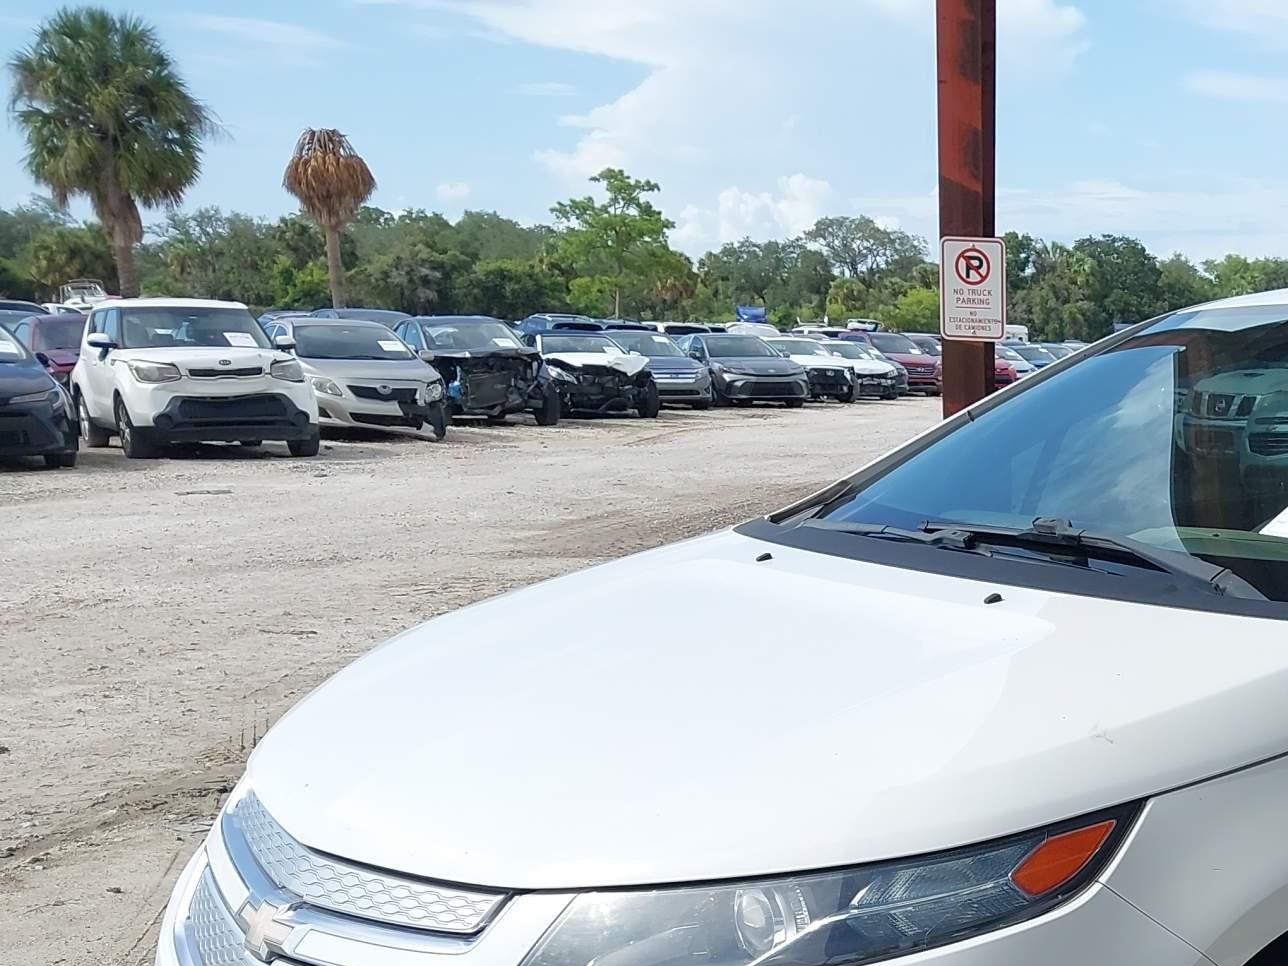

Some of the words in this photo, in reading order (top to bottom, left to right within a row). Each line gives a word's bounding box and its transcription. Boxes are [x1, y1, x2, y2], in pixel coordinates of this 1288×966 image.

[953, 288, 964, 296] NO
[967, 288, 992, 297] TRUCK
[955, 297, 991, 306] PARKING
